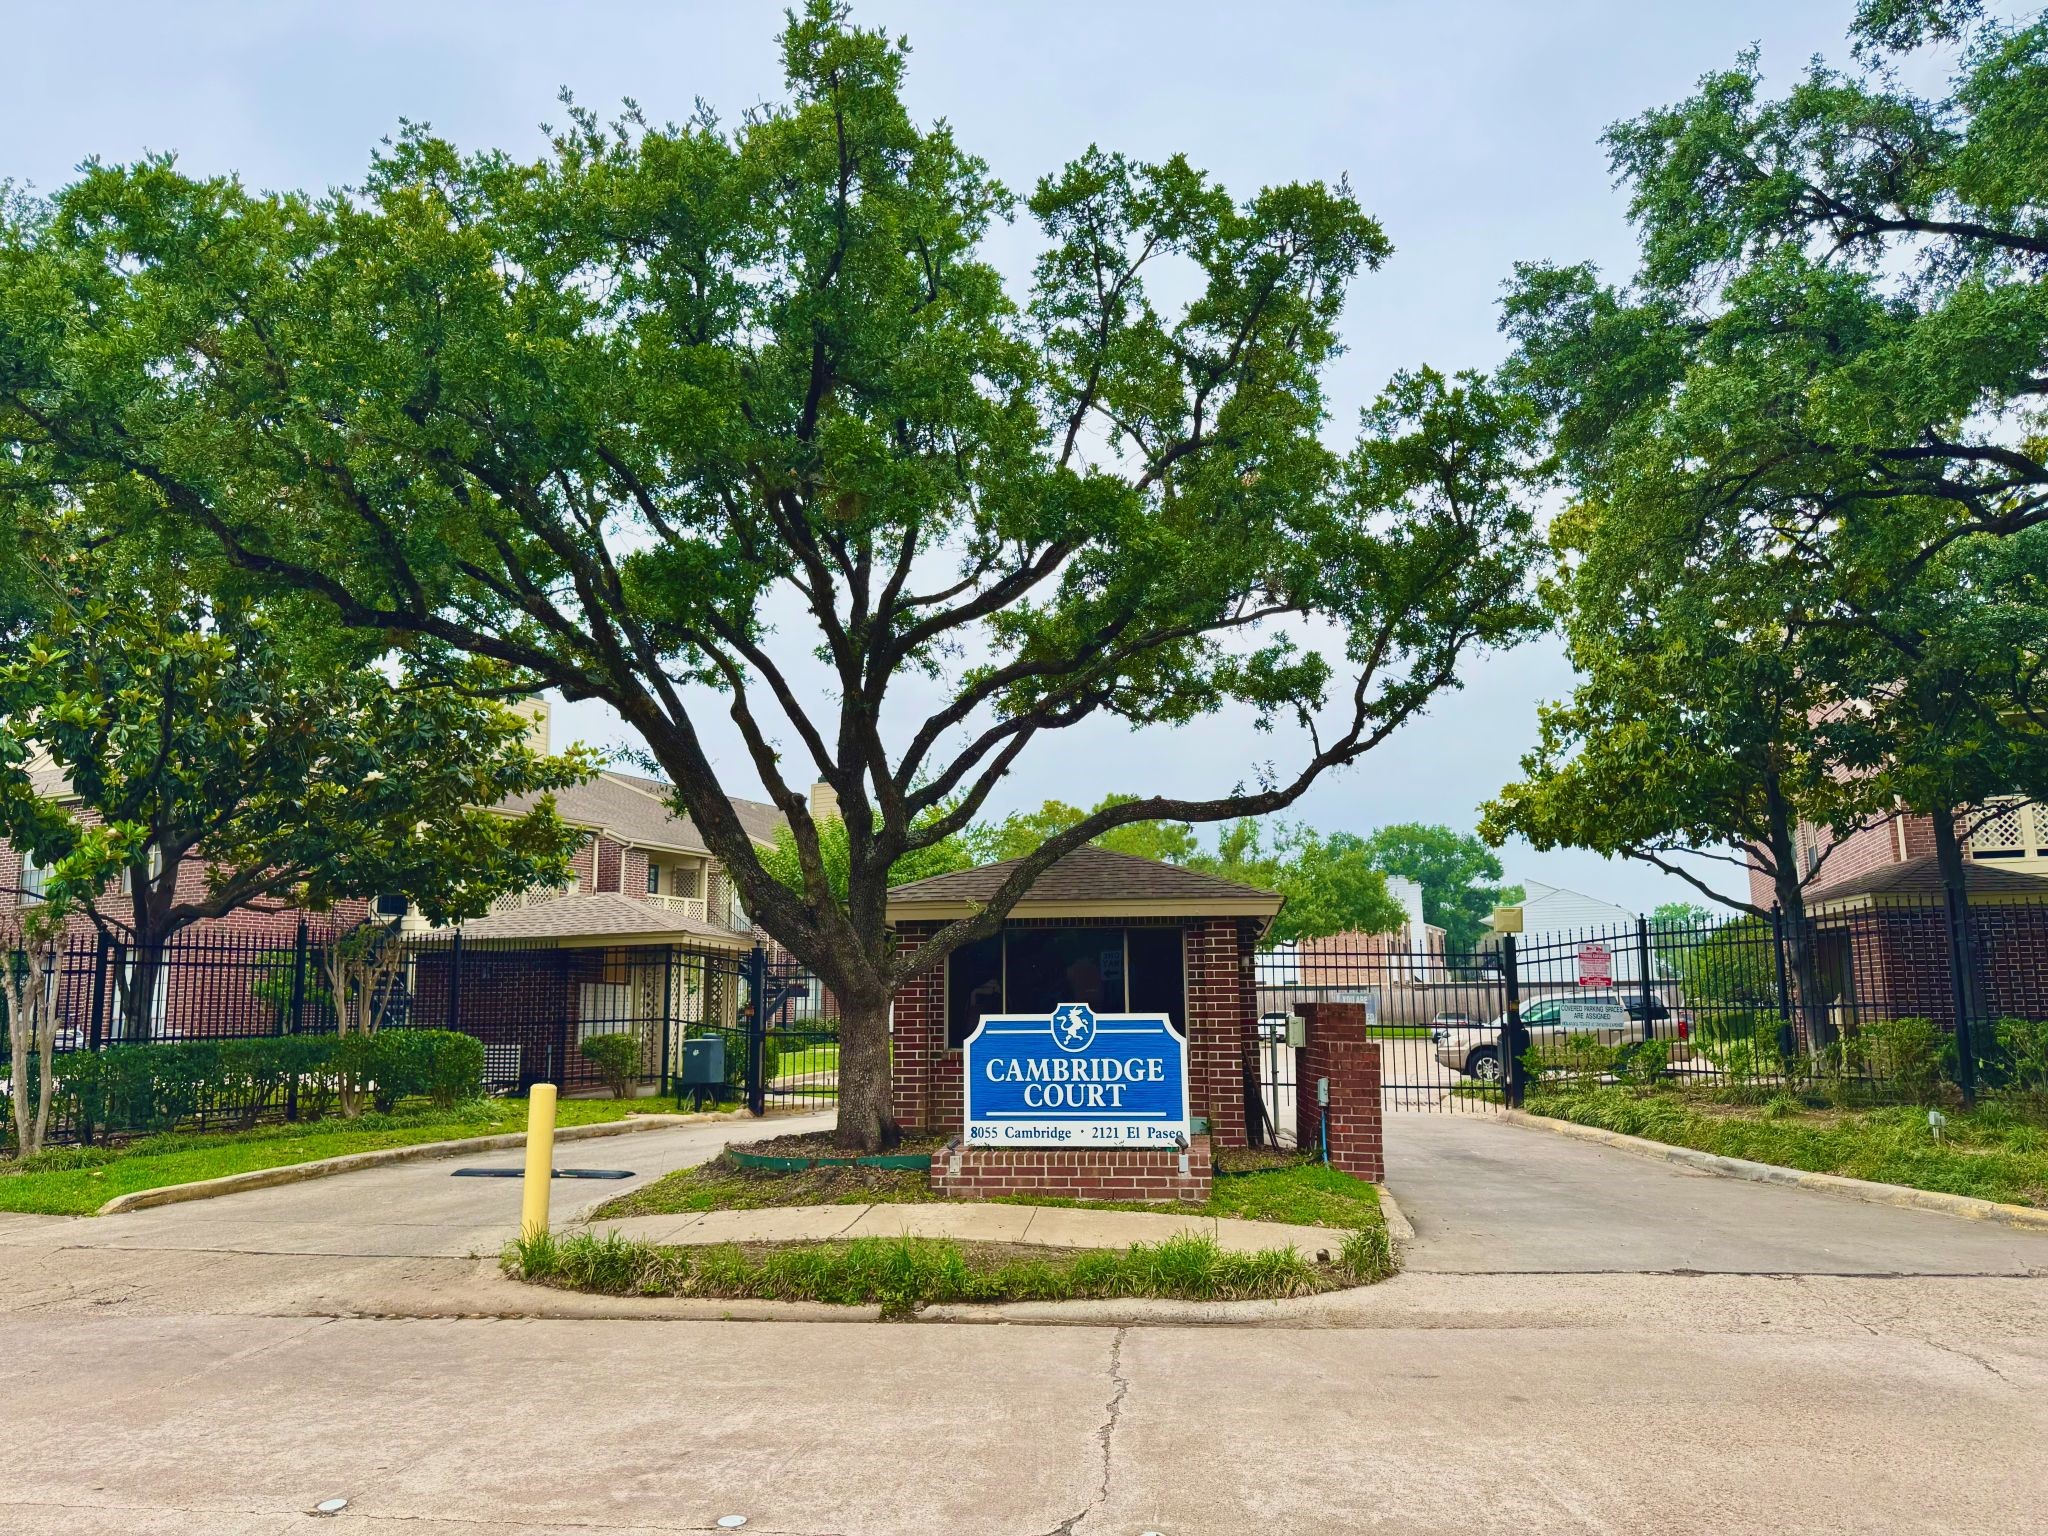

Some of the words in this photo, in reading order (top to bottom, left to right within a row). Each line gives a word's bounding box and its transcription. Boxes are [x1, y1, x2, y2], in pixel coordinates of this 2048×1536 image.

[986, 1058, 1165, 1082] CAMBRIDGE
[1024, 1084, 1126, 1107] COURT
[971, 1126, 998, 1139] 8055
[1005, 1126, 1072, 1142] Cambridge
[1092, 1127, 1119, 1139] 2121
[1127, 1127, 1140, 1139] El
[1147, 1127, 1183, 1139] Paseo
